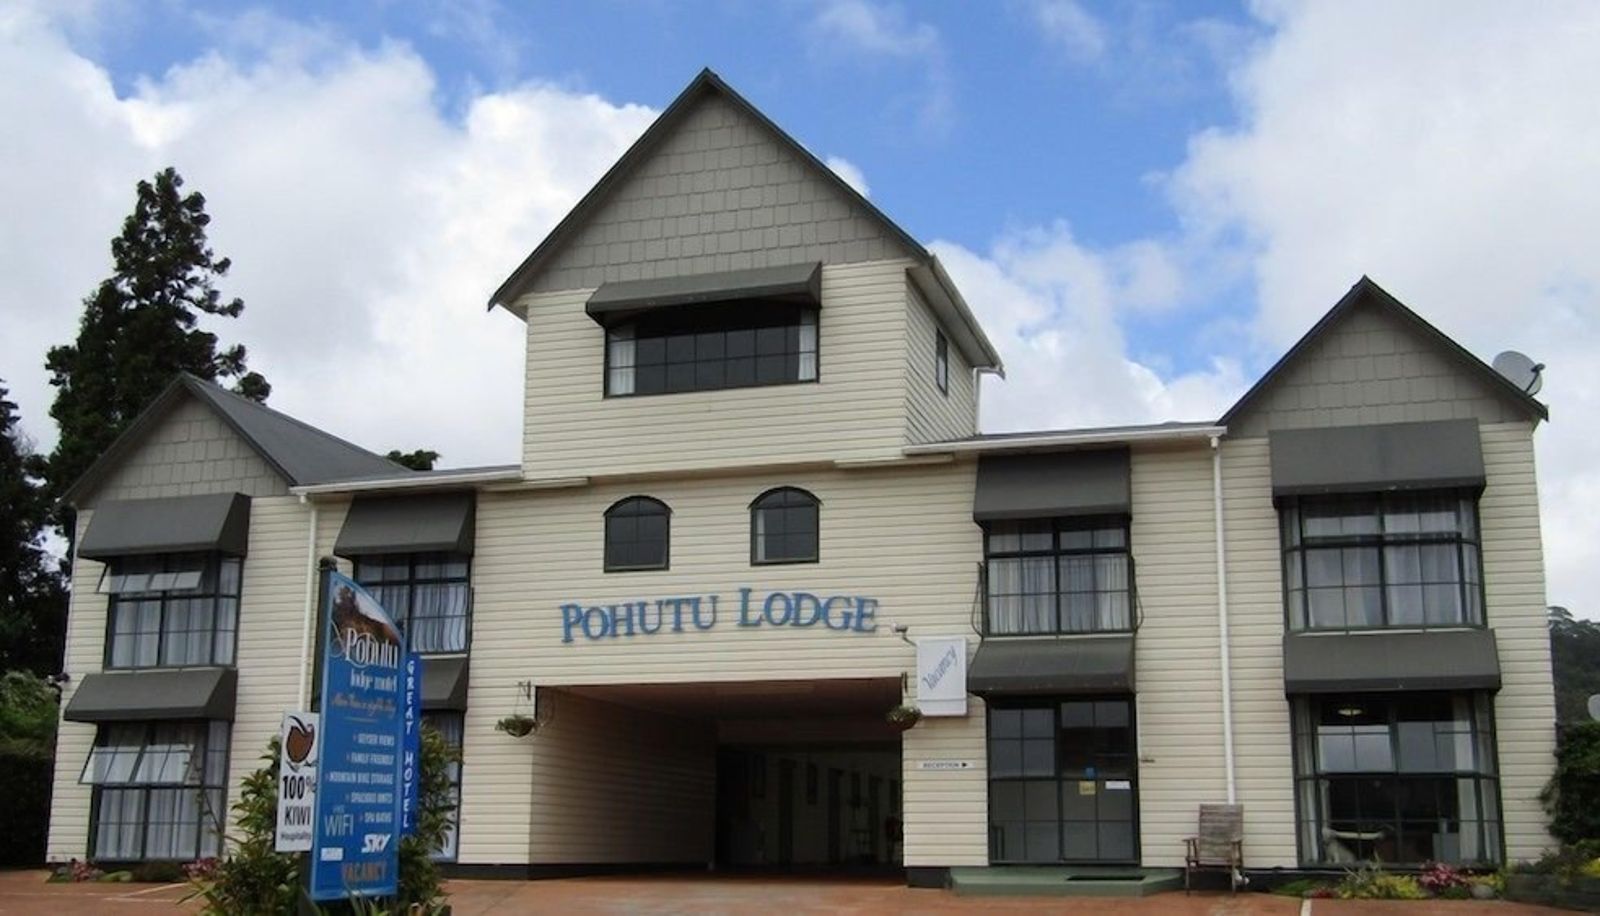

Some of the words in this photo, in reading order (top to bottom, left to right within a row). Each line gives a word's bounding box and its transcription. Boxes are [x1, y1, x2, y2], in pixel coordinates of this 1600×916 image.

[558, 595, 719, 643] POHUTU
[737, 587, 879, 634] LODGE
[284, 806, 311, 826] KIWI
[323, 813, 355, 837] WIFI
[361, 833, 392, 854] SKY
